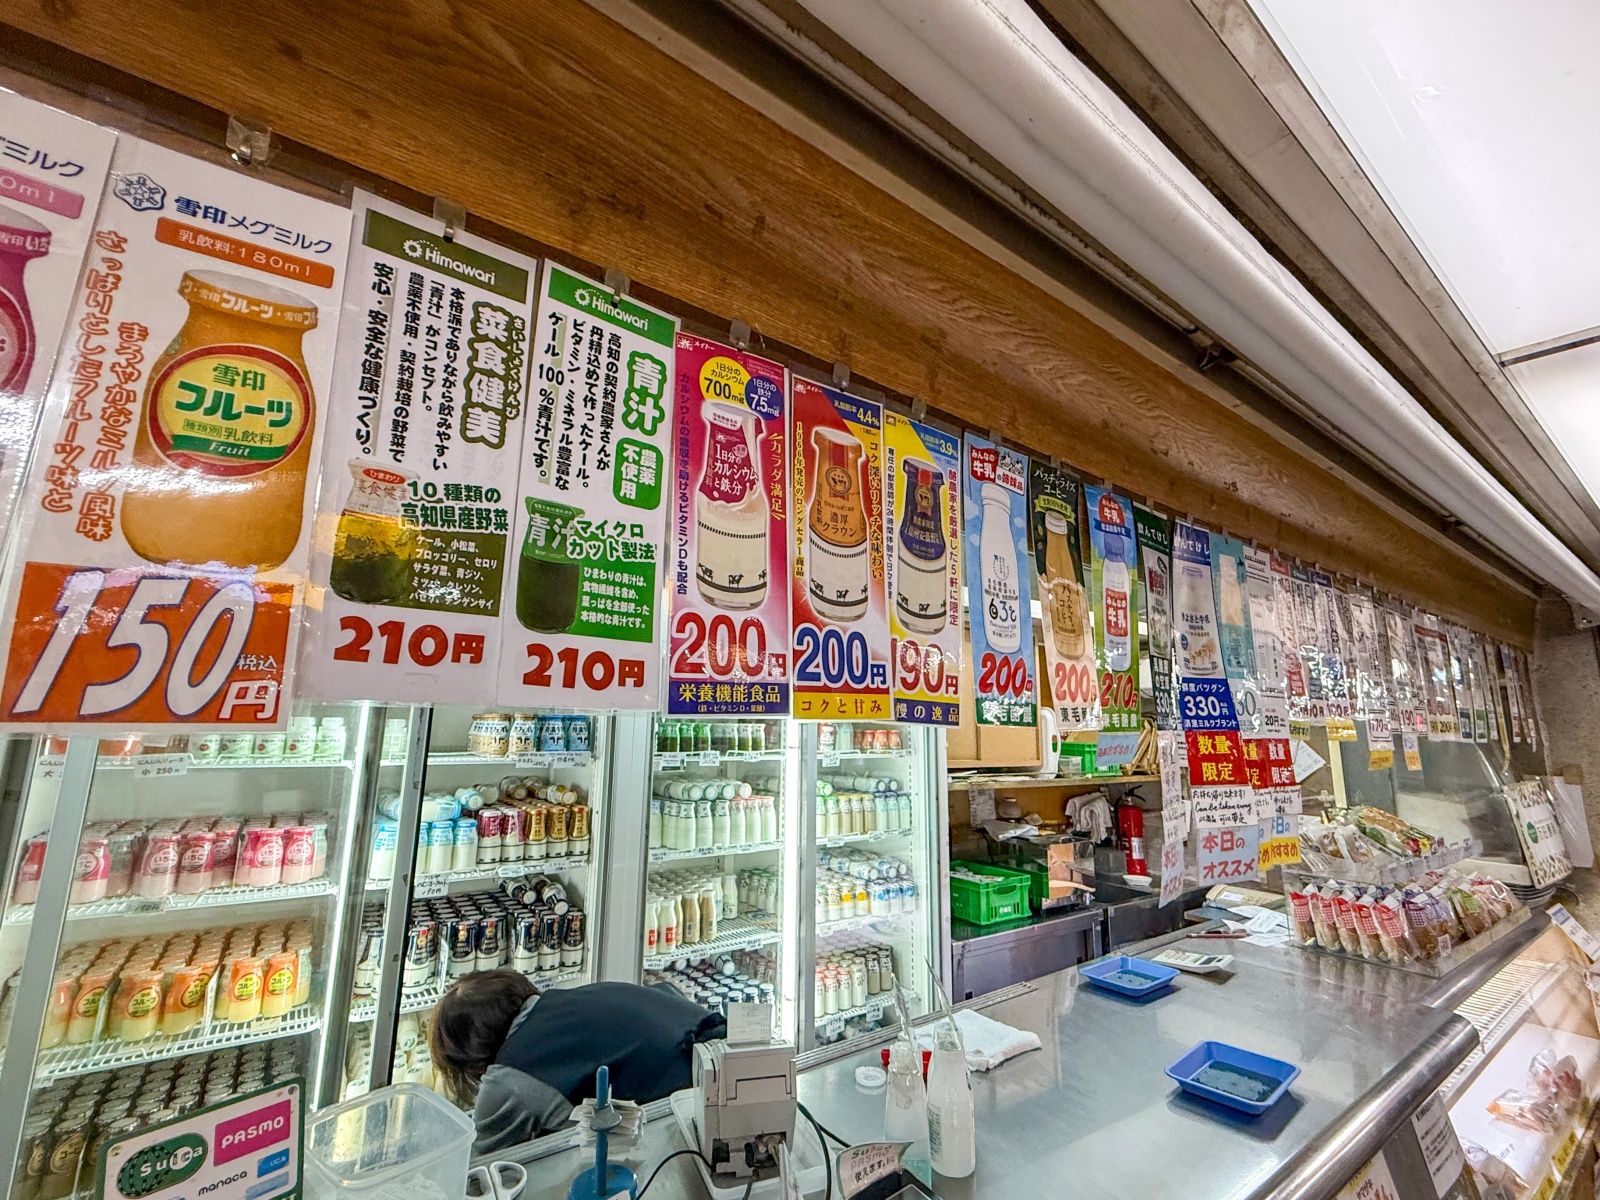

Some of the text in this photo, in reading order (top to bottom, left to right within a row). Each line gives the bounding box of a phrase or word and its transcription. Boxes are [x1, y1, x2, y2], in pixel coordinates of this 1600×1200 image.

[0, 137, 84, 177] ミルク
[173, 195, 333, 254] 雪印メグミルク
[424, 250, 496, 286] Himawari
[592, 296, 649, 331] Himawari
[355, 261, 395, 455] 安心・安全な健康づくり。
[389, 271, 424, 463] 農薬不使用・契約栽培の野菜で
[211, 363, 267, 391] 雪印
[432, 286, 465, 470] 本格派でありながら飲みやすい
[462, 302, 513, 449] 菜食健美
[710, 369, 745, 386] カルシウム
[715, 362, 741, 377] 1日分の
[624, 353, 664, 434] 青汁
[753, 378, 777, 391] 1日分の
[175, 380, 293, 428] フルーツ
[555, 318, 587, 491] ビタミン・ミネラル豊富な
[596, 332, 622, 471] 高知の契約農家さんが
[76, 321, 149, 542] まろやかなミル風味
[223, 428, 274, 445] 乳飲料
[209, 442, 251, 457] Fruit
[971, 449, 995, 462] みんなの
[369, 469, 400, 483] ひまわり
[714, 460, 758, 480] カルシウム
[770, 440, 783, 512] カラダ満足
[973, 461, 995, 479] 牛乳
[714, 477, 742, 495] と鉄分
[1044, 484, 1067, 499] コーヒー
[401, 503, 508, 532] 高知県産野菜
[869, 441, 883, 579] コク深いリッチな味わい
[1103, 507, 1120, 523] 牛乳
[576, 519, 644, 539] マイクロ
[822, 522, 857, 537] クラウン
[568, 539, 657, 560] カット製法
[583, 566, 647, 587] ひまわりの青汁は、
[581, 596, 650, 615] 葉っぱを全部使った
[580, 610, 646, 628] 本格的な青汁です。
[333, 615, 485, 667] 210円
[674, 611, 787, 677] 200円
[237, 654, 279, 672] 税込
[796, 626, 887, 686] 200円
[522, 643, 645, 691] 210円
[679, 683, 781, 703] 栄養機能食品
[1100, 672, 1138, 710] 210円
[801, 699, 882, 715] コクと甘み
[1197, 735, 1231, 755] 数量
[1268, 743, 1287, 760] 数量
[1201, 762, 1235, 782] 限定
[1271, 767, 1290, 784] 限定
[1202, 831, 1245, 853] 本日の
[1203, 858, 1256, 879] オススメ
[221, 1116, 285, 1149] PASMO
[140, 1146, 203, 1178] Suica
[198, 1170, 248, 1197] manaca
